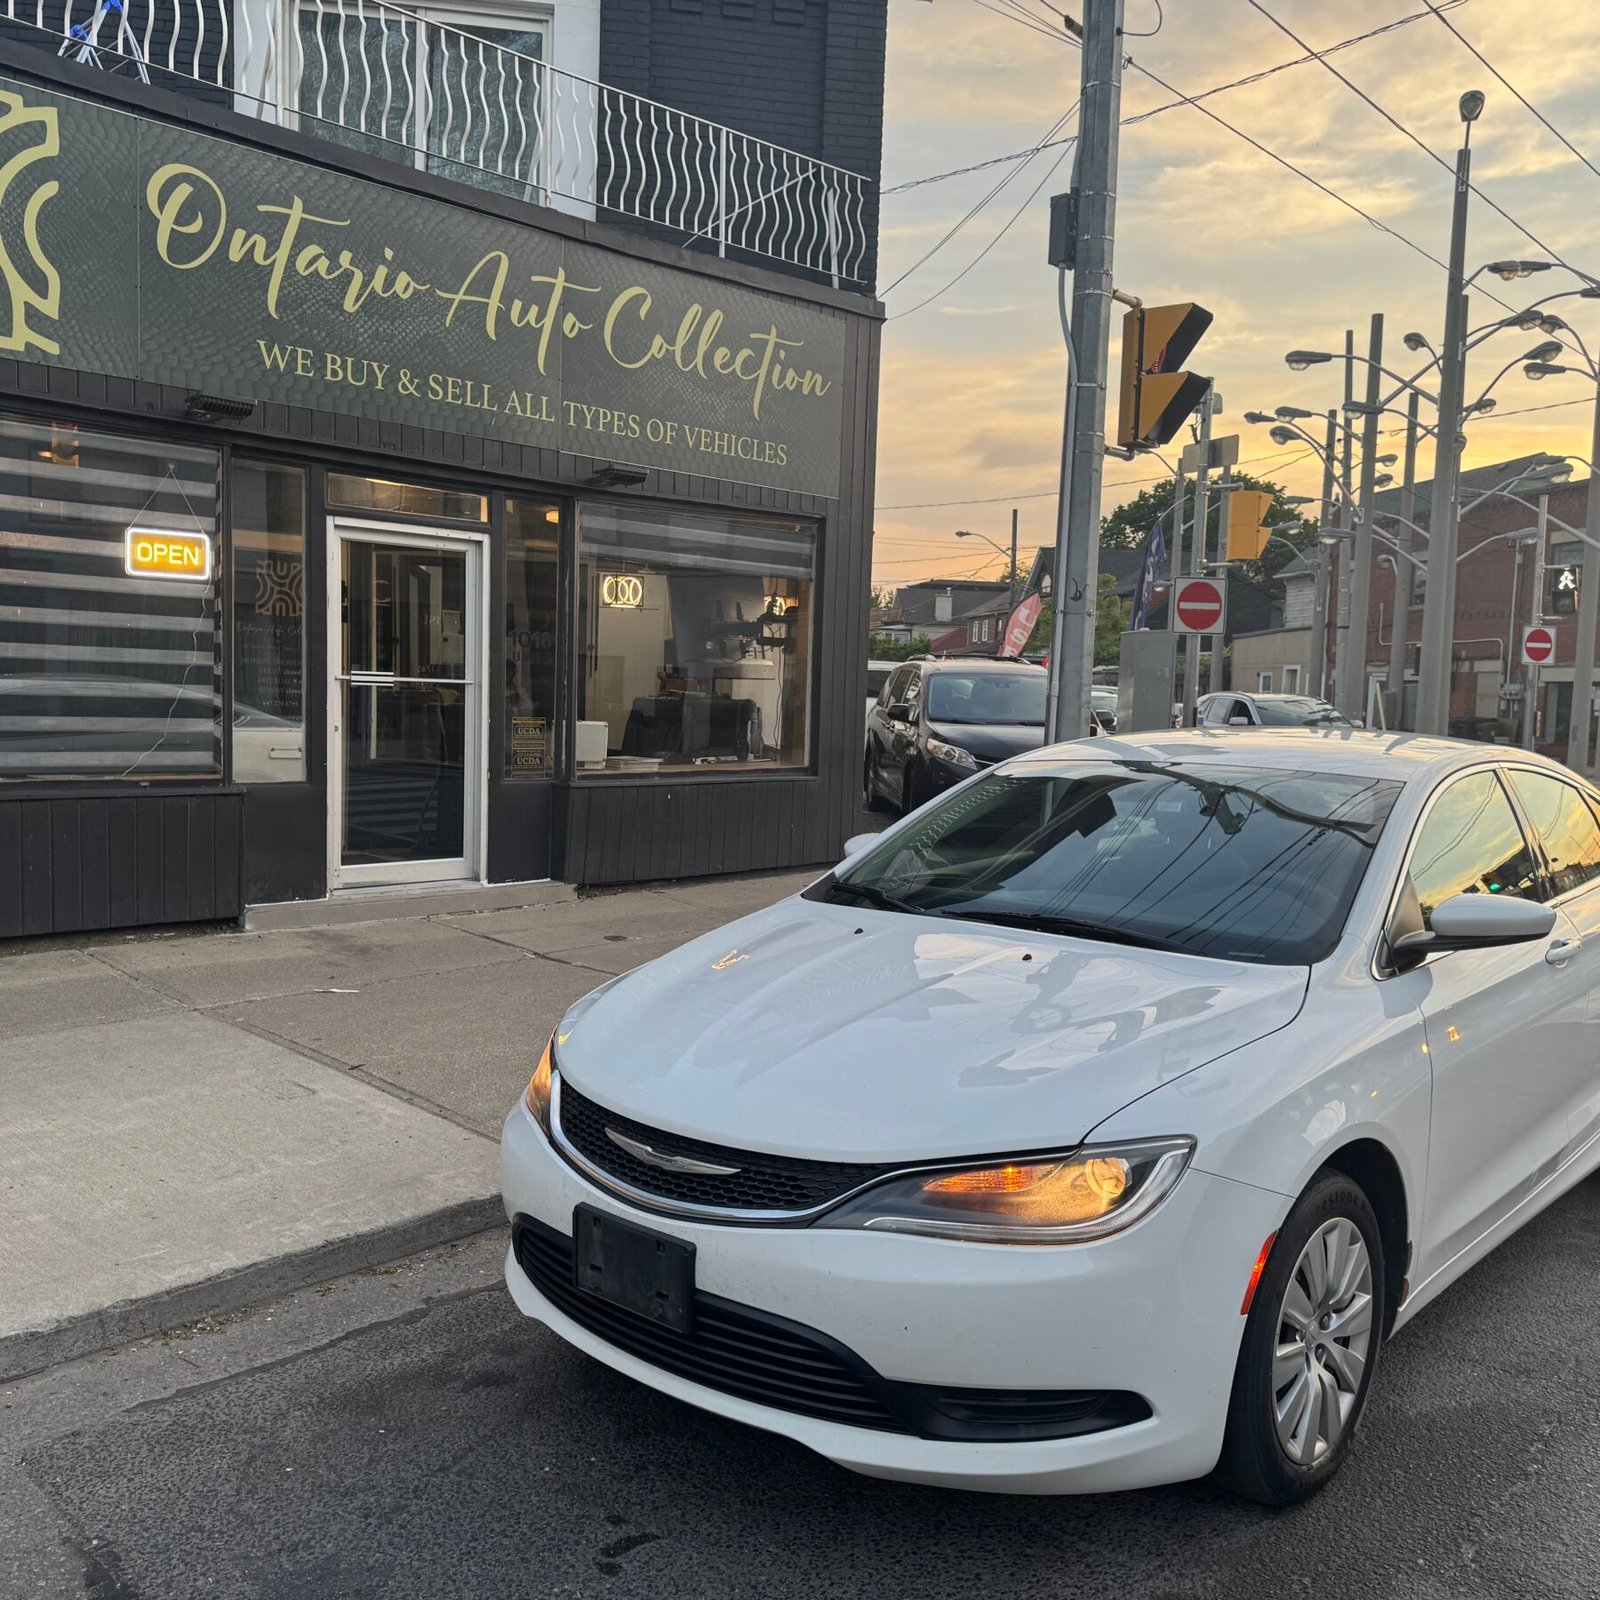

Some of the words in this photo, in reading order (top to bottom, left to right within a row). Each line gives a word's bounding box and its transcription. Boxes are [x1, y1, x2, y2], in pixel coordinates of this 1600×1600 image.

[147, 163, 430, 319] Ontario
[435, 250, 602, 376] Auto
[604, 286, 831, 421] Collection
[256, 339, 315, 377] WE
[324, 352, 390, 390] BUY
[397, 368, 421, 397] &
[428, 373, 498, 411] SELL
[503, 390, 555, 422] ALL
[563, 401, 640, 438] TYPES
[646, 418, 678, 445] OF
[683, 425, 787, 466] VEHICLES
[136, 542, 199, 566] OPEN
[518, 727, 541, 735] UCDA
[517, 757, 541, 765] UCDA
